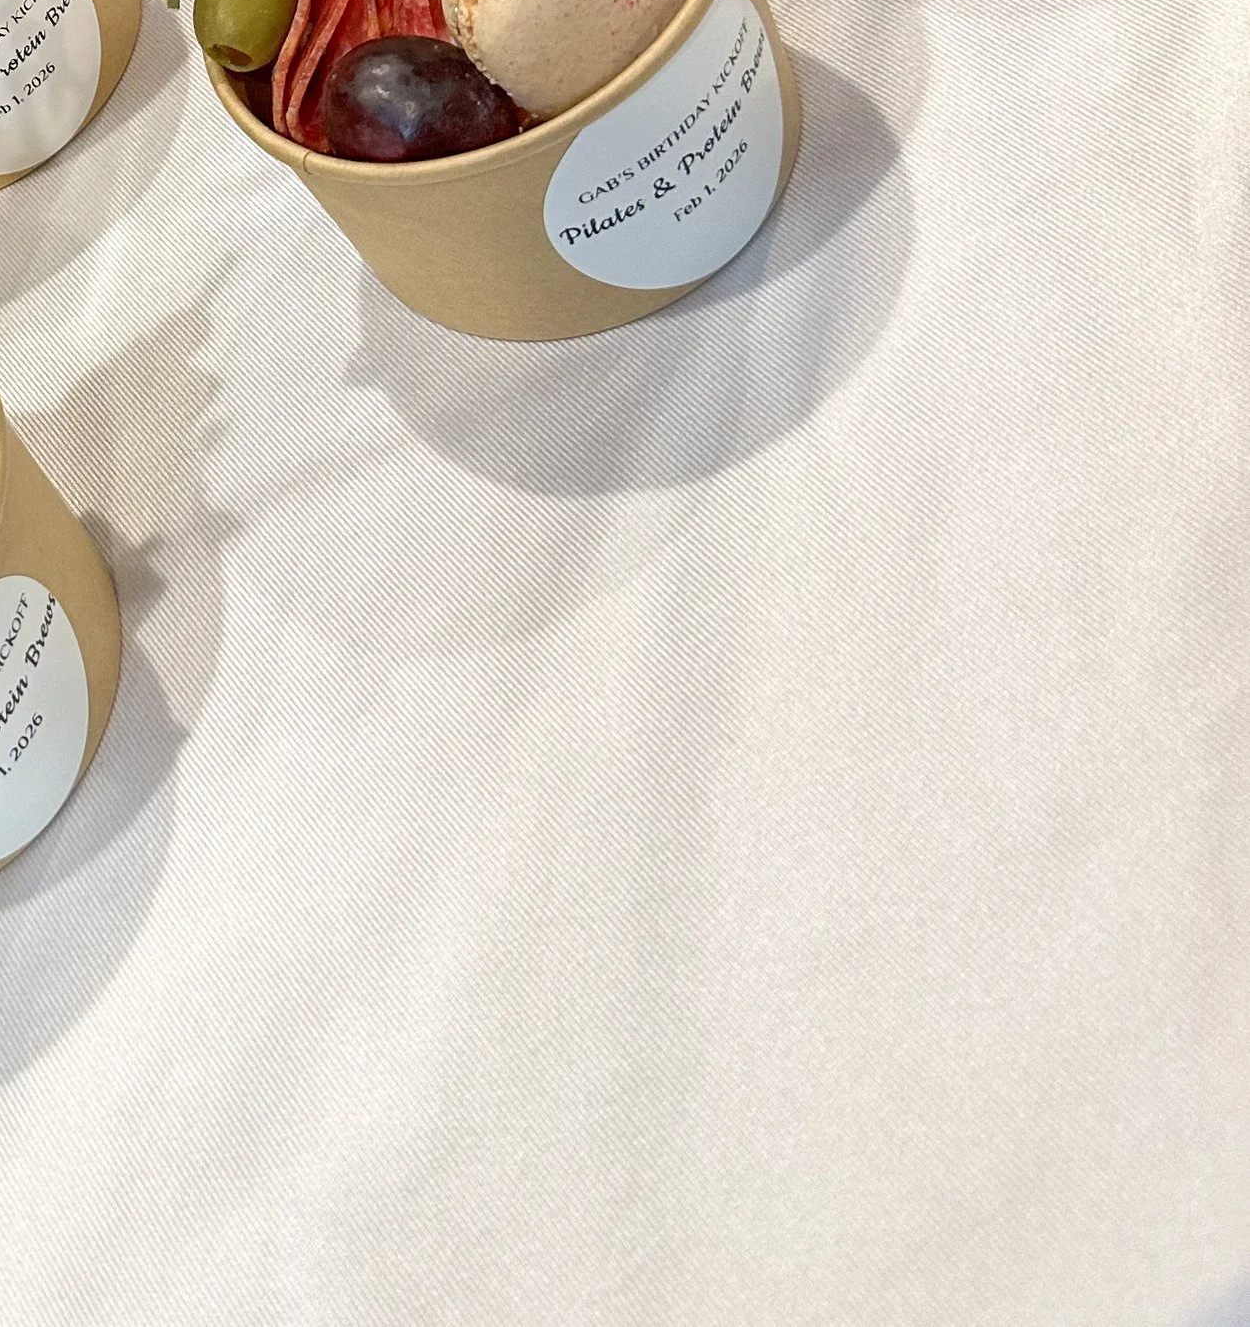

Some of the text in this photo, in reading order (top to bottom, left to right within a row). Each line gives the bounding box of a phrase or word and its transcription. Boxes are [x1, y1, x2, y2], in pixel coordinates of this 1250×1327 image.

[23, 61, 56, 96] 2026
[578, 17, 749, 205] GAB'S BIRTHDAY KICKOFF
[559, 31, 765, 245] Pilates & Protein Brews
[674, 196, 702, 222] Feb
[716, 138, 748, 183] 2026
[25, 593, 57, 667] Brews
[9, 712, 44, 762] 2026
